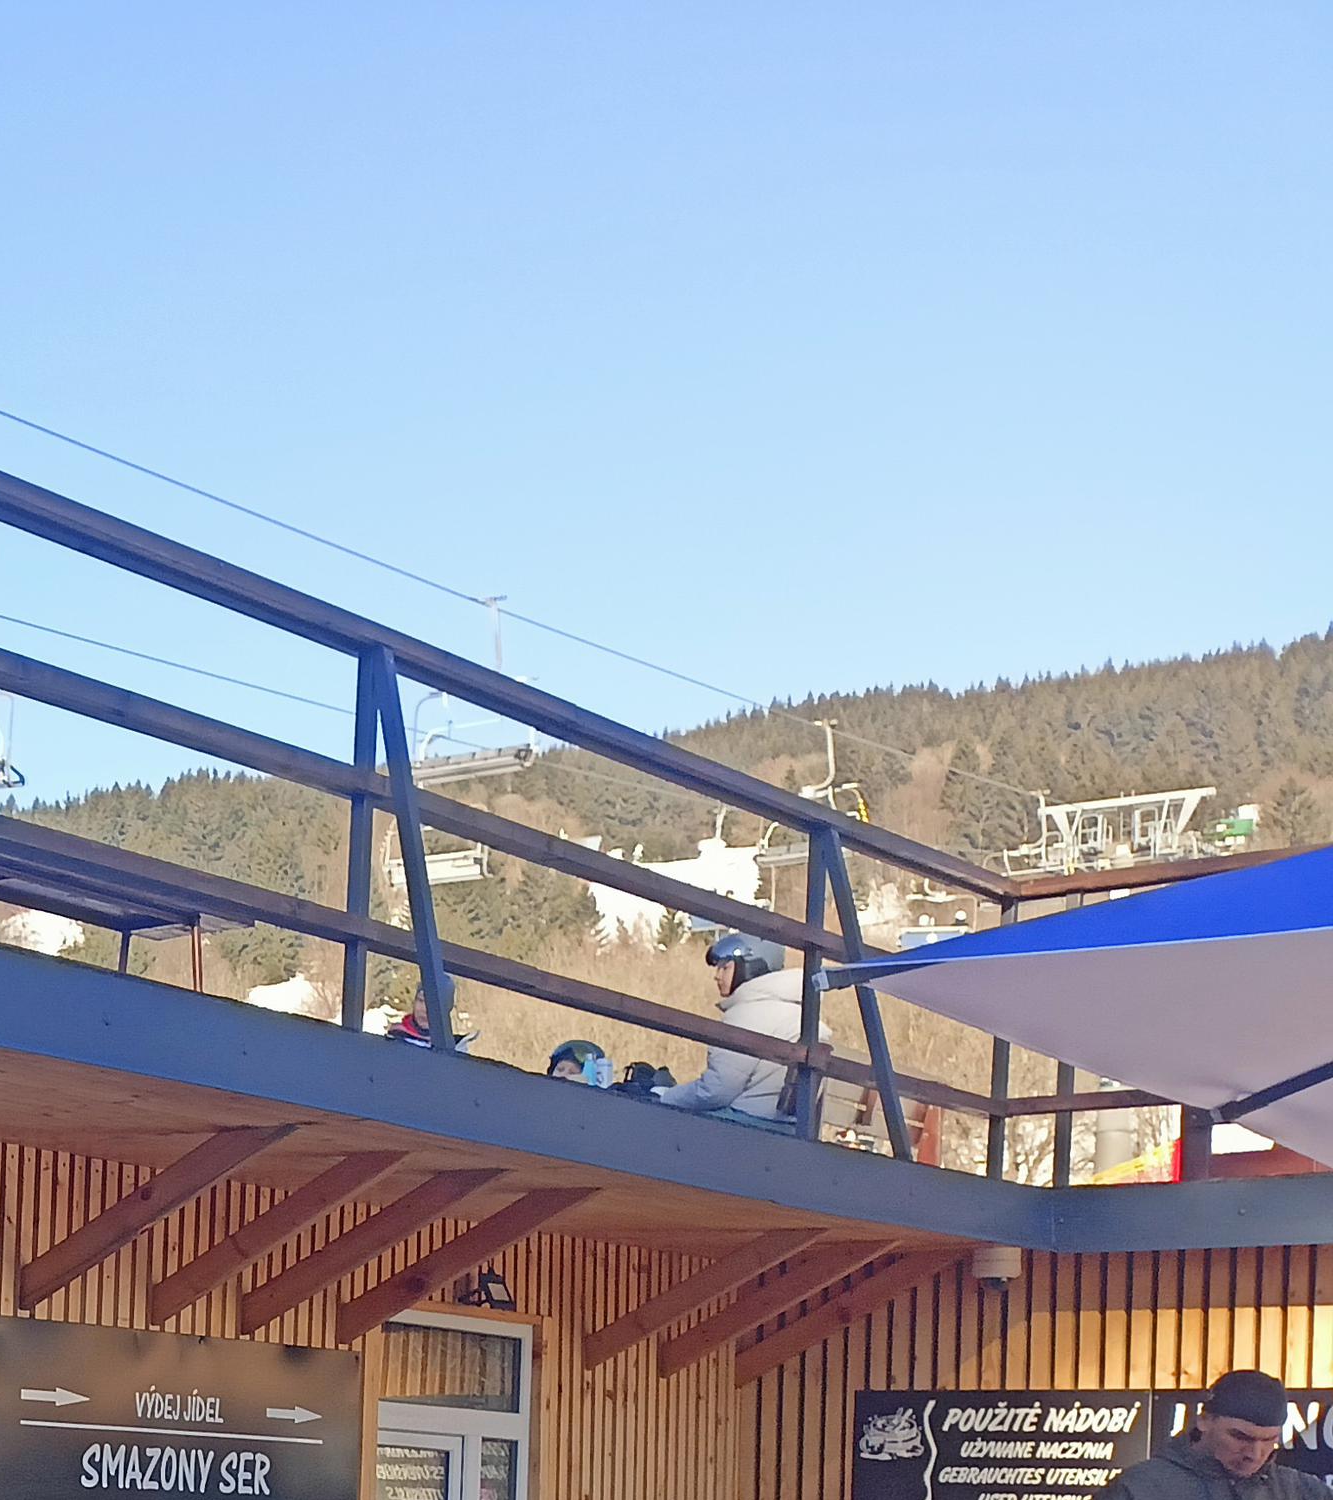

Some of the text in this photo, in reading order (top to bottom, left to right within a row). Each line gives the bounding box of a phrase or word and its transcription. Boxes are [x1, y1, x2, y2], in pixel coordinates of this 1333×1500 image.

[135, 1385, 224, 1424] VÝDEJ JÍDEL
[942, 1400, 1042, 1432] POUŽITÉ
[1043, 1400, 1142, 1433] NÁDOBÍ
[1036, 1441, 1115, 1461] NACZYNIA
[81, 1443, 271, 1495] SMAZONY SER
[938, 1466, 1044, 1485] GEBRAUCHTES
